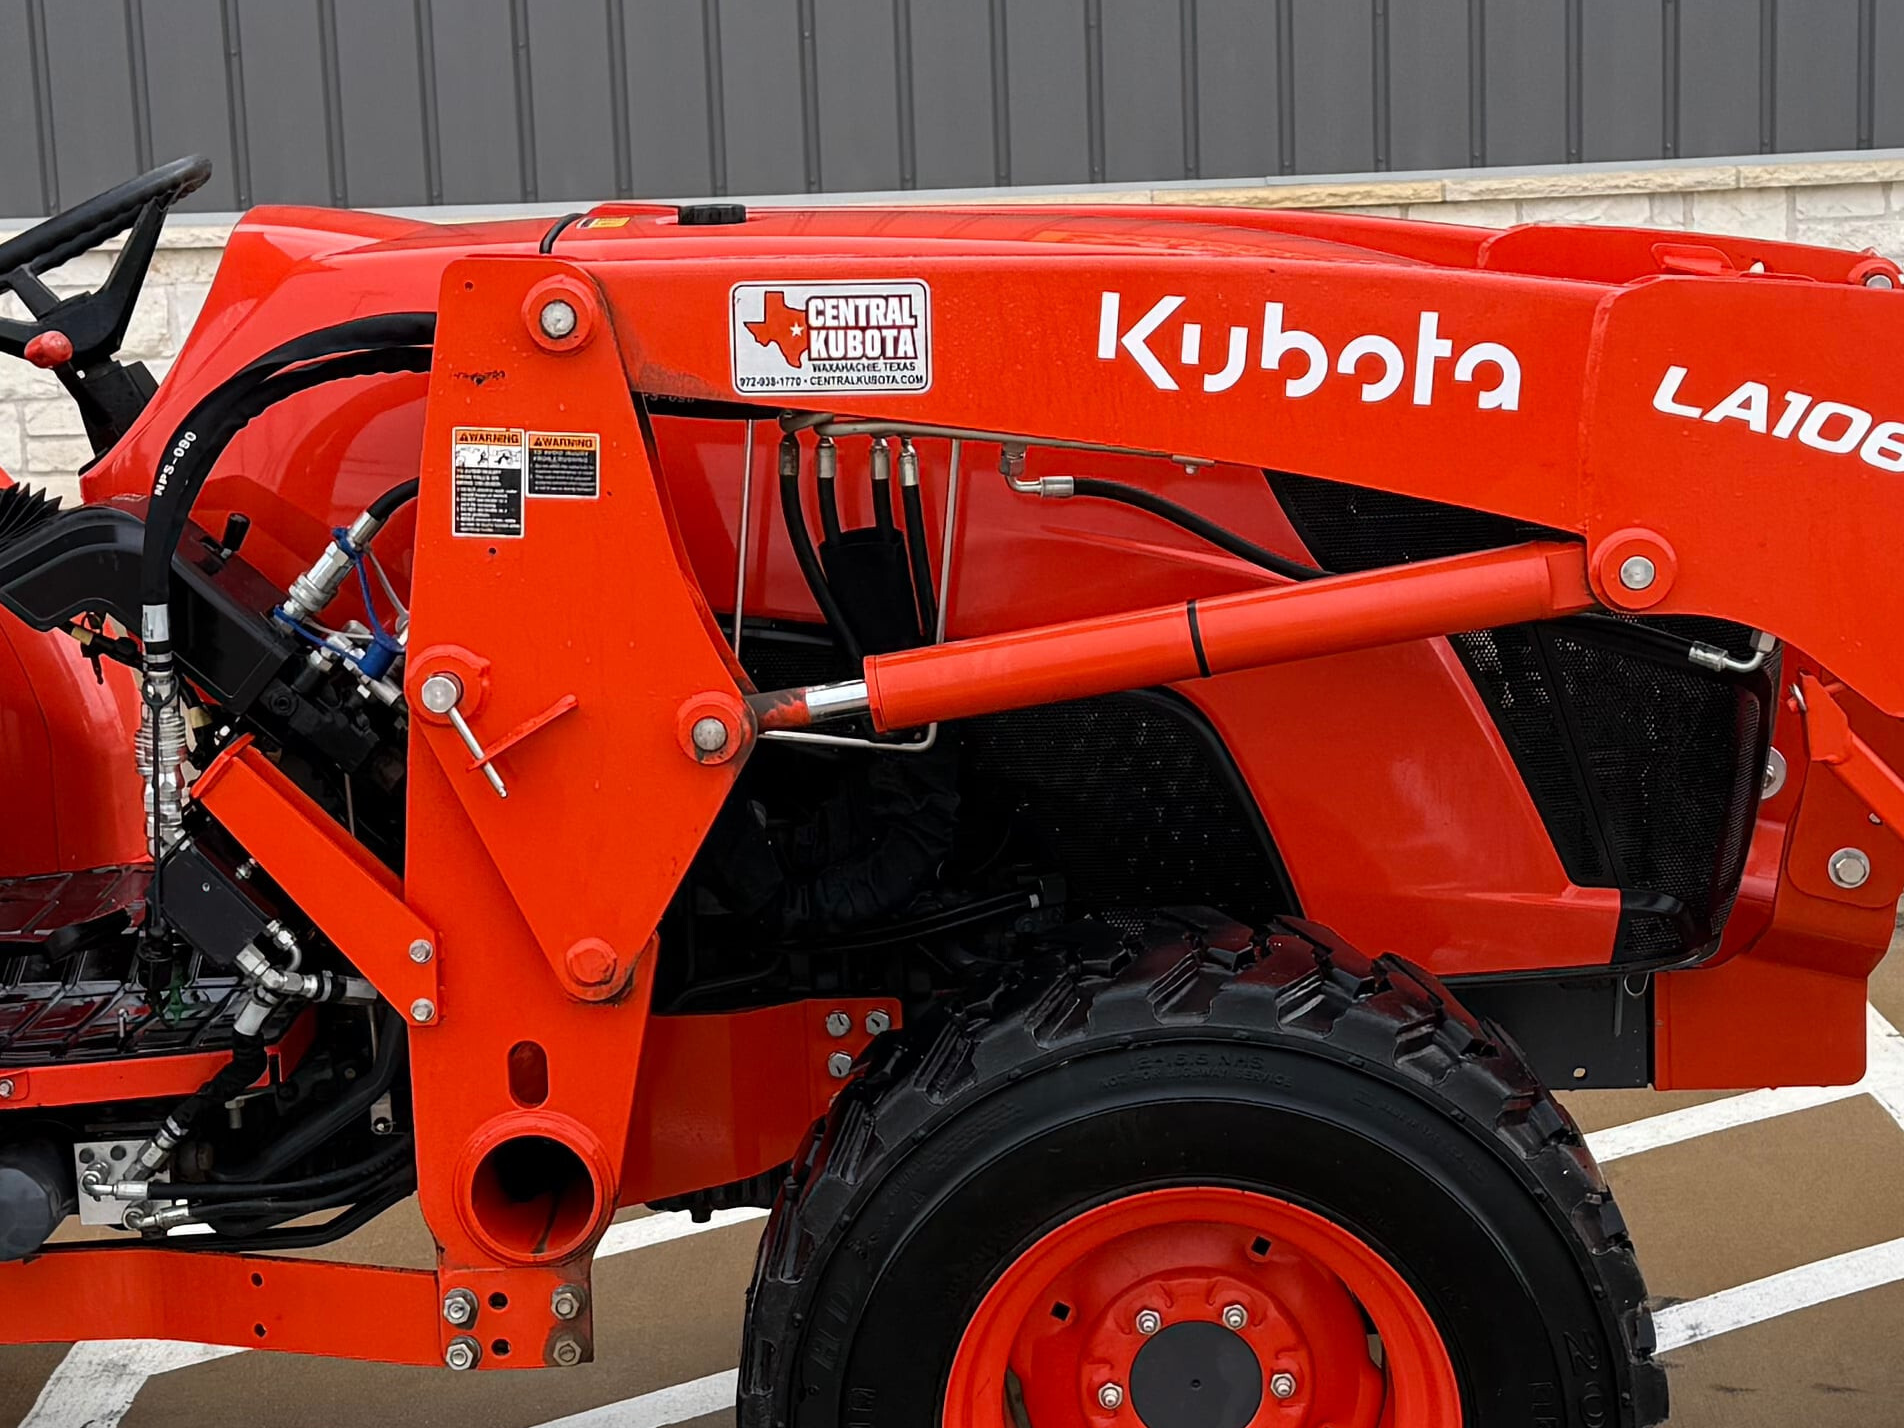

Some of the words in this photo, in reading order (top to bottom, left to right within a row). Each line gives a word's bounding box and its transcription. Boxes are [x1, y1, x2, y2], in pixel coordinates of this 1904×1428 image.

[807, 294, 917, 327] CENTRAL
[808, 328, 917, 359] KUBOTA
[1096, 290, 1523, 412] Kubota
[884, 361, 916, 372] TEXAS
[468, 433, 520, 444] WARNING
[542, 437, 593, 448] WARNING
